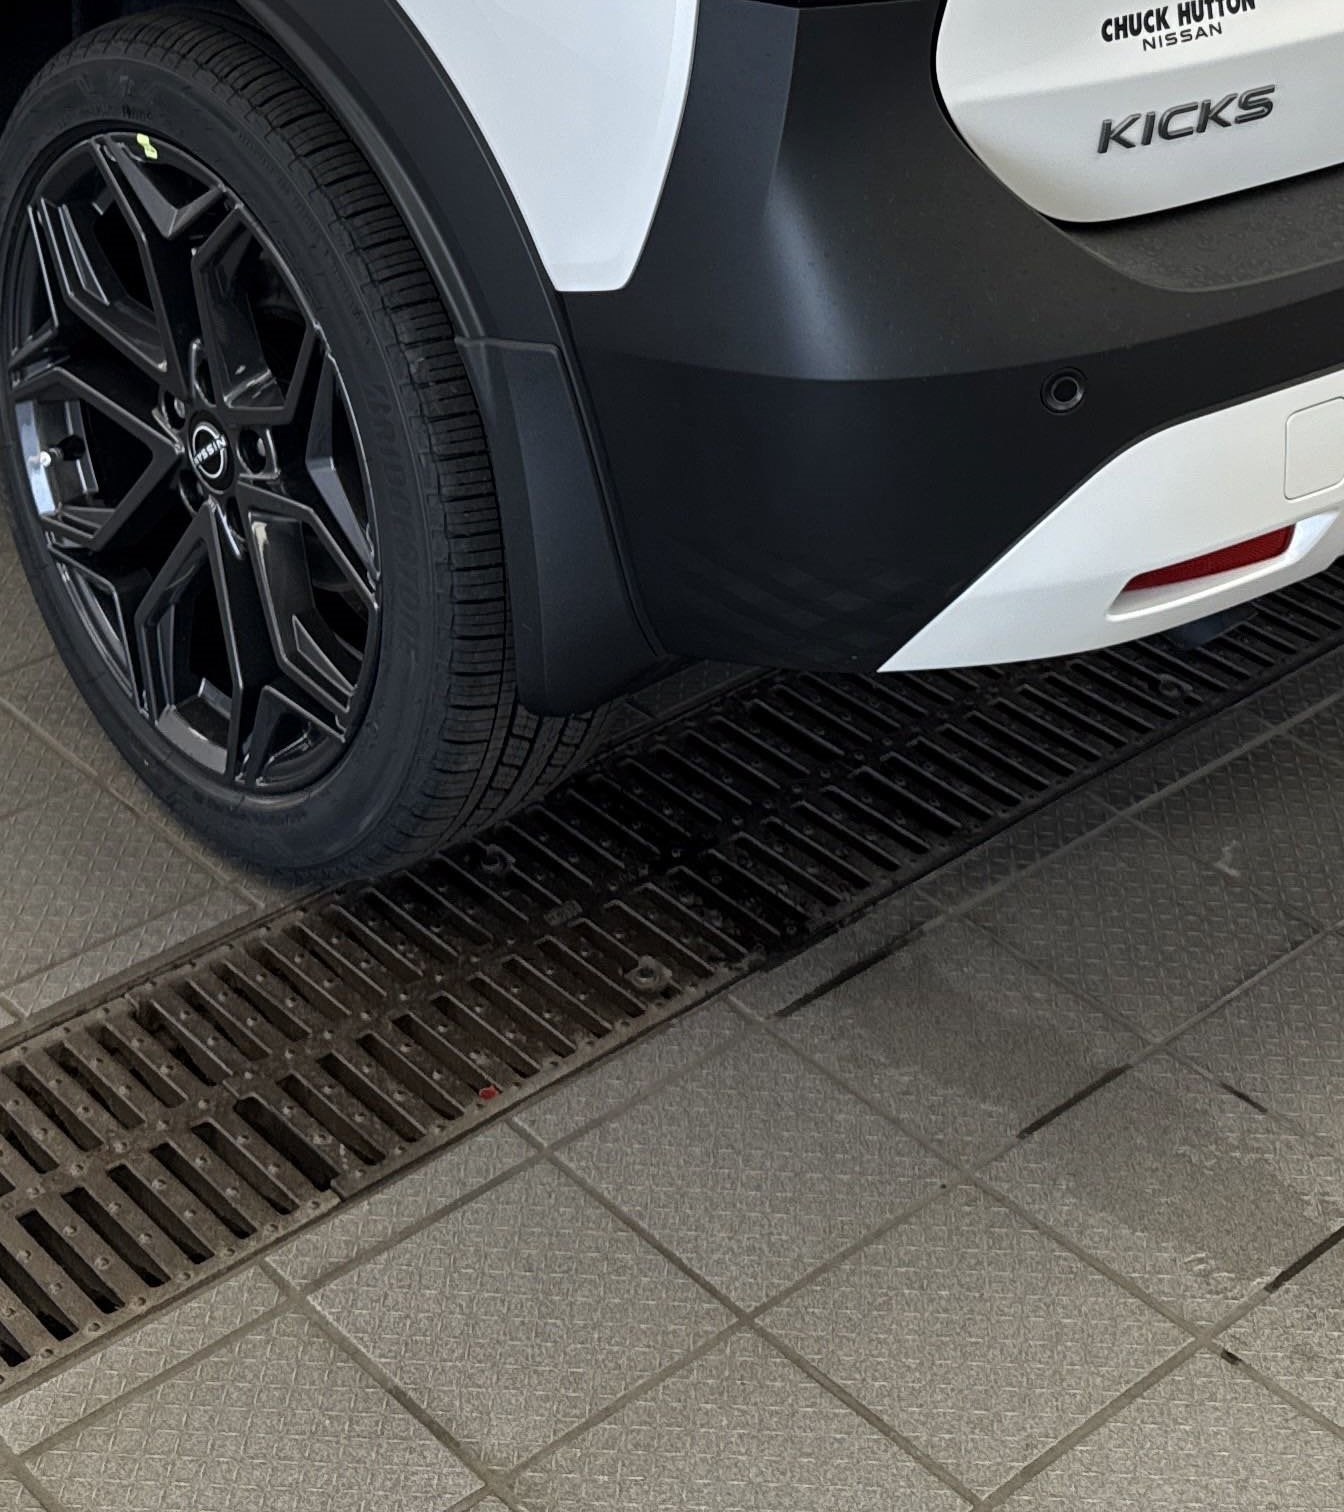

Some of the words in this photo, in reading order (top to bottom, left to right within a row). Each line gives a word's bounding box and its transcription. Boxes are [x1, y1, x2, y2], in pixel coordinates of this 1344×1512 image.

[1101, 6, 1169, 42] CHUCK
[1142, 22, 1223, 51] NISSAN
[1097, 85, 1275, 154] KICKS
[193, 434, 226, 465] NISSAN
